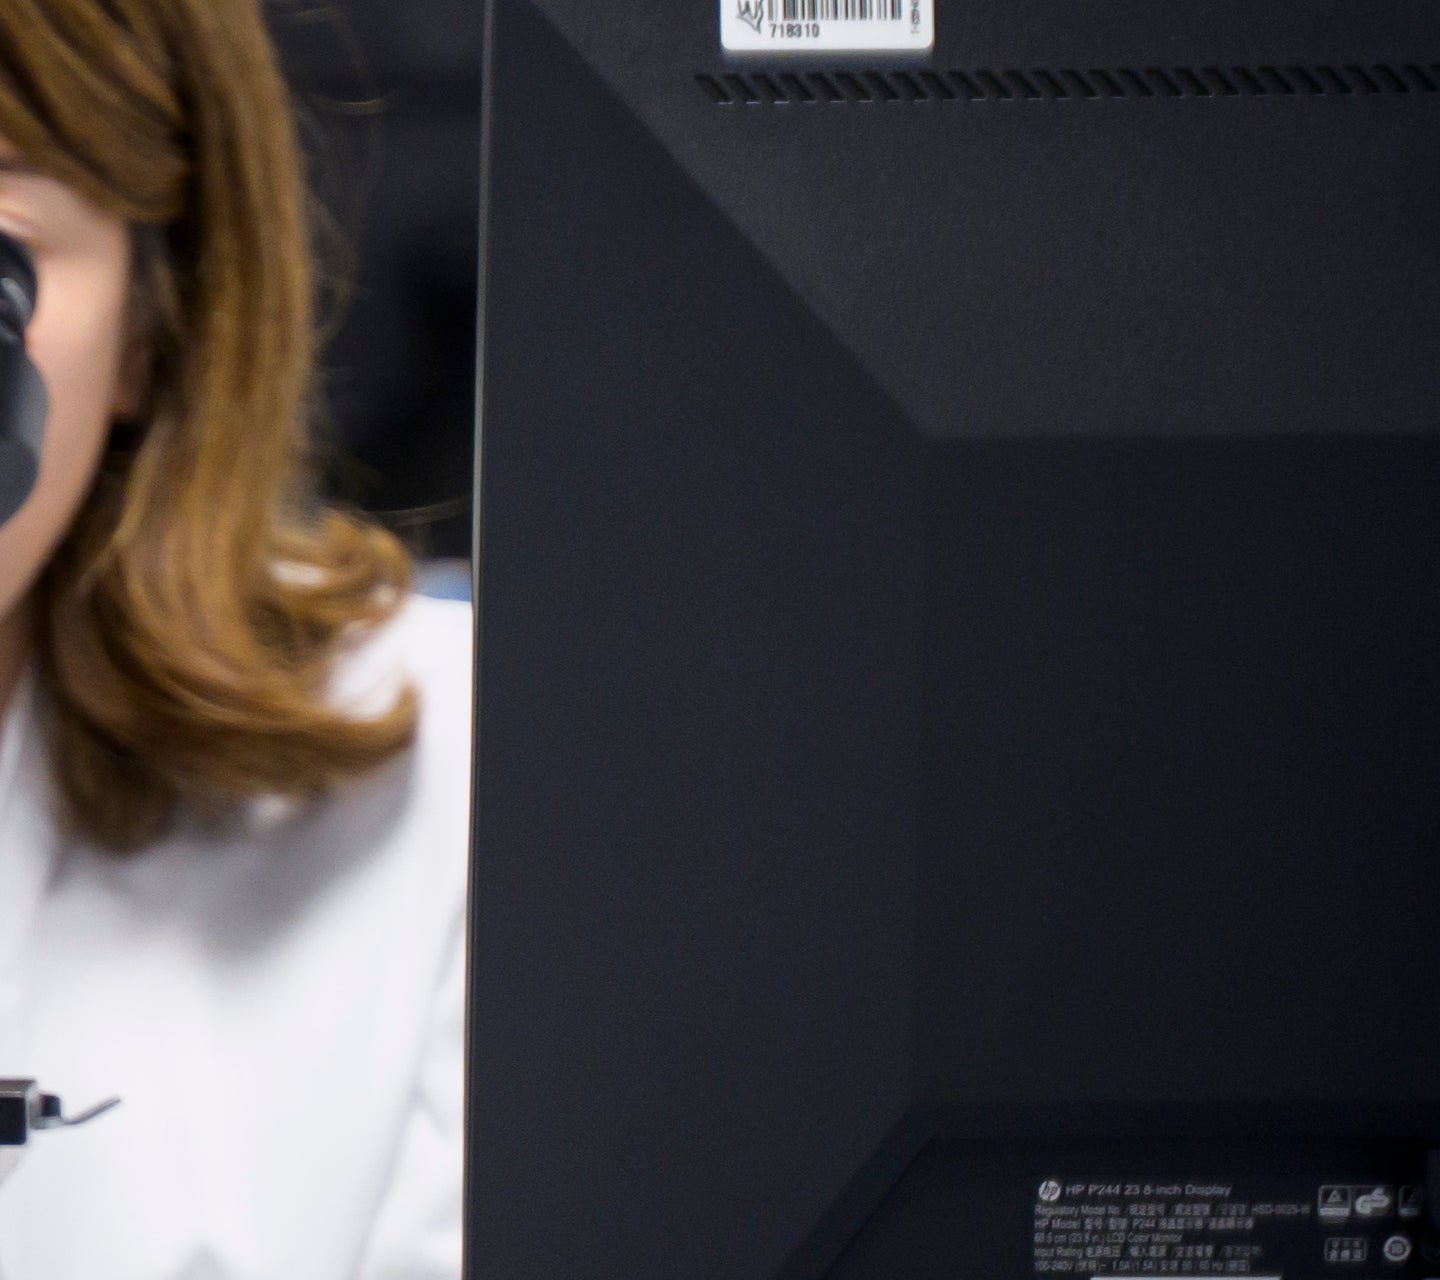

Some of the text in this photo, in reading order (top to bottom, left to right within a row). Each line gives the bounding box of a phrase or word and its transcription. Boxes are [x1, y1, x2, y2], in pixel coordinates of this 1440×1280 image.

[1065, 1184, 1085, 1195] HP
[1088, 1184, 1120, 1195] P244
[1185, 1184, 1233, 1198] Display
